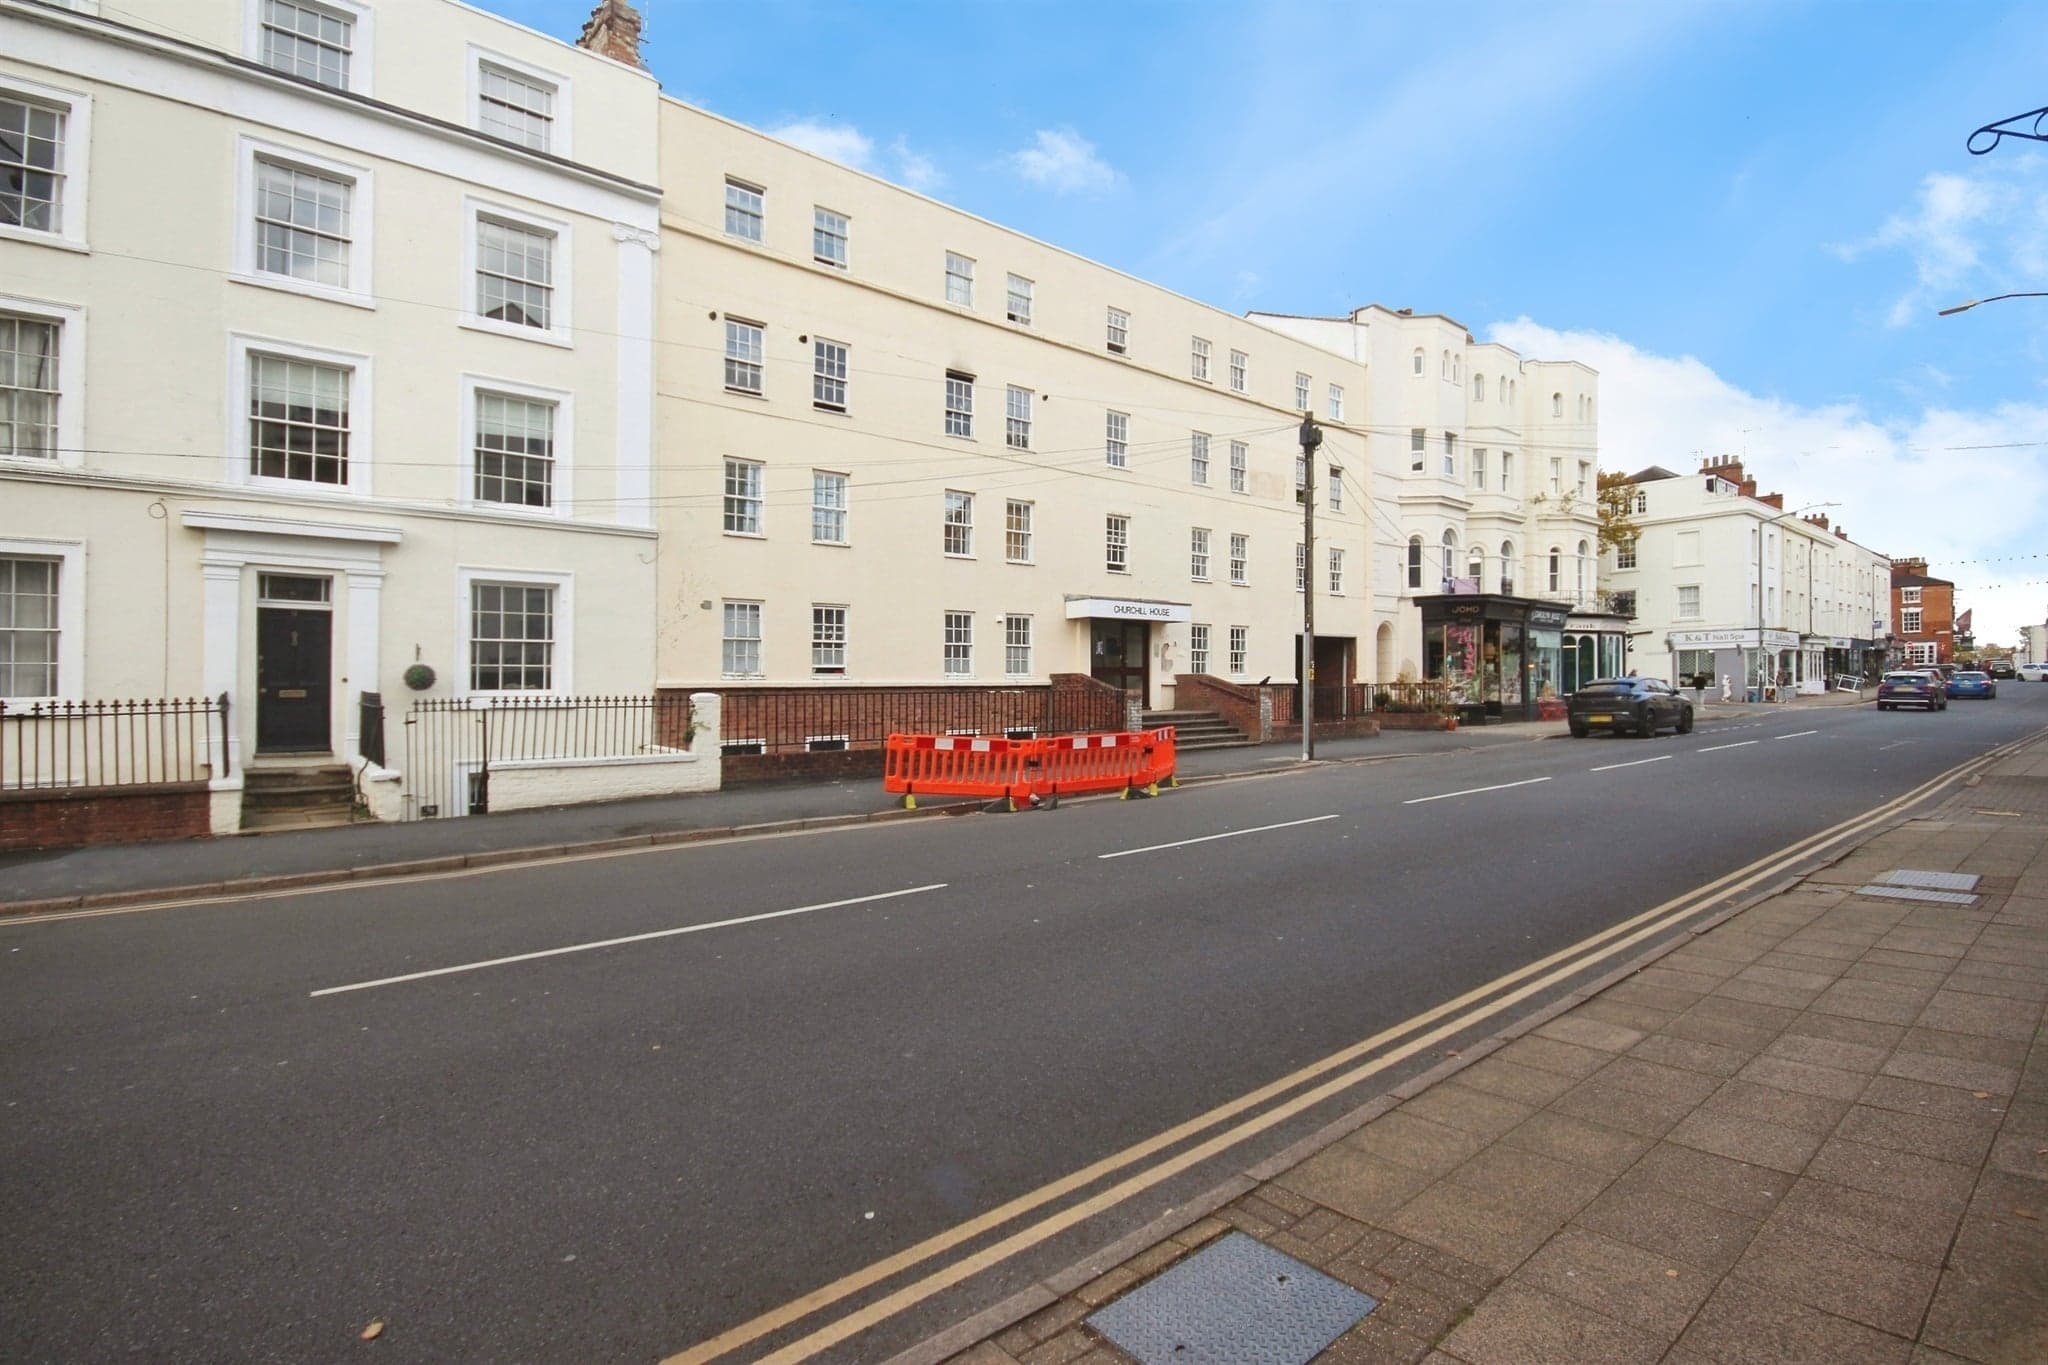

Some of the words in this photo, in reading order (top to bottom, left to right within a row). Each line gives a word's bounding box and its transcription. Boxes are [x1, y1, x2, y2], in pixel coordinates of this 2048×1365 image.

[1113, 605, 1147, 615] CHURCHILL
[1149, 607, 1170, 617] HOUSE
[1685, 633, 1694, 642] K
[1702, 632, 1712, 641] T
